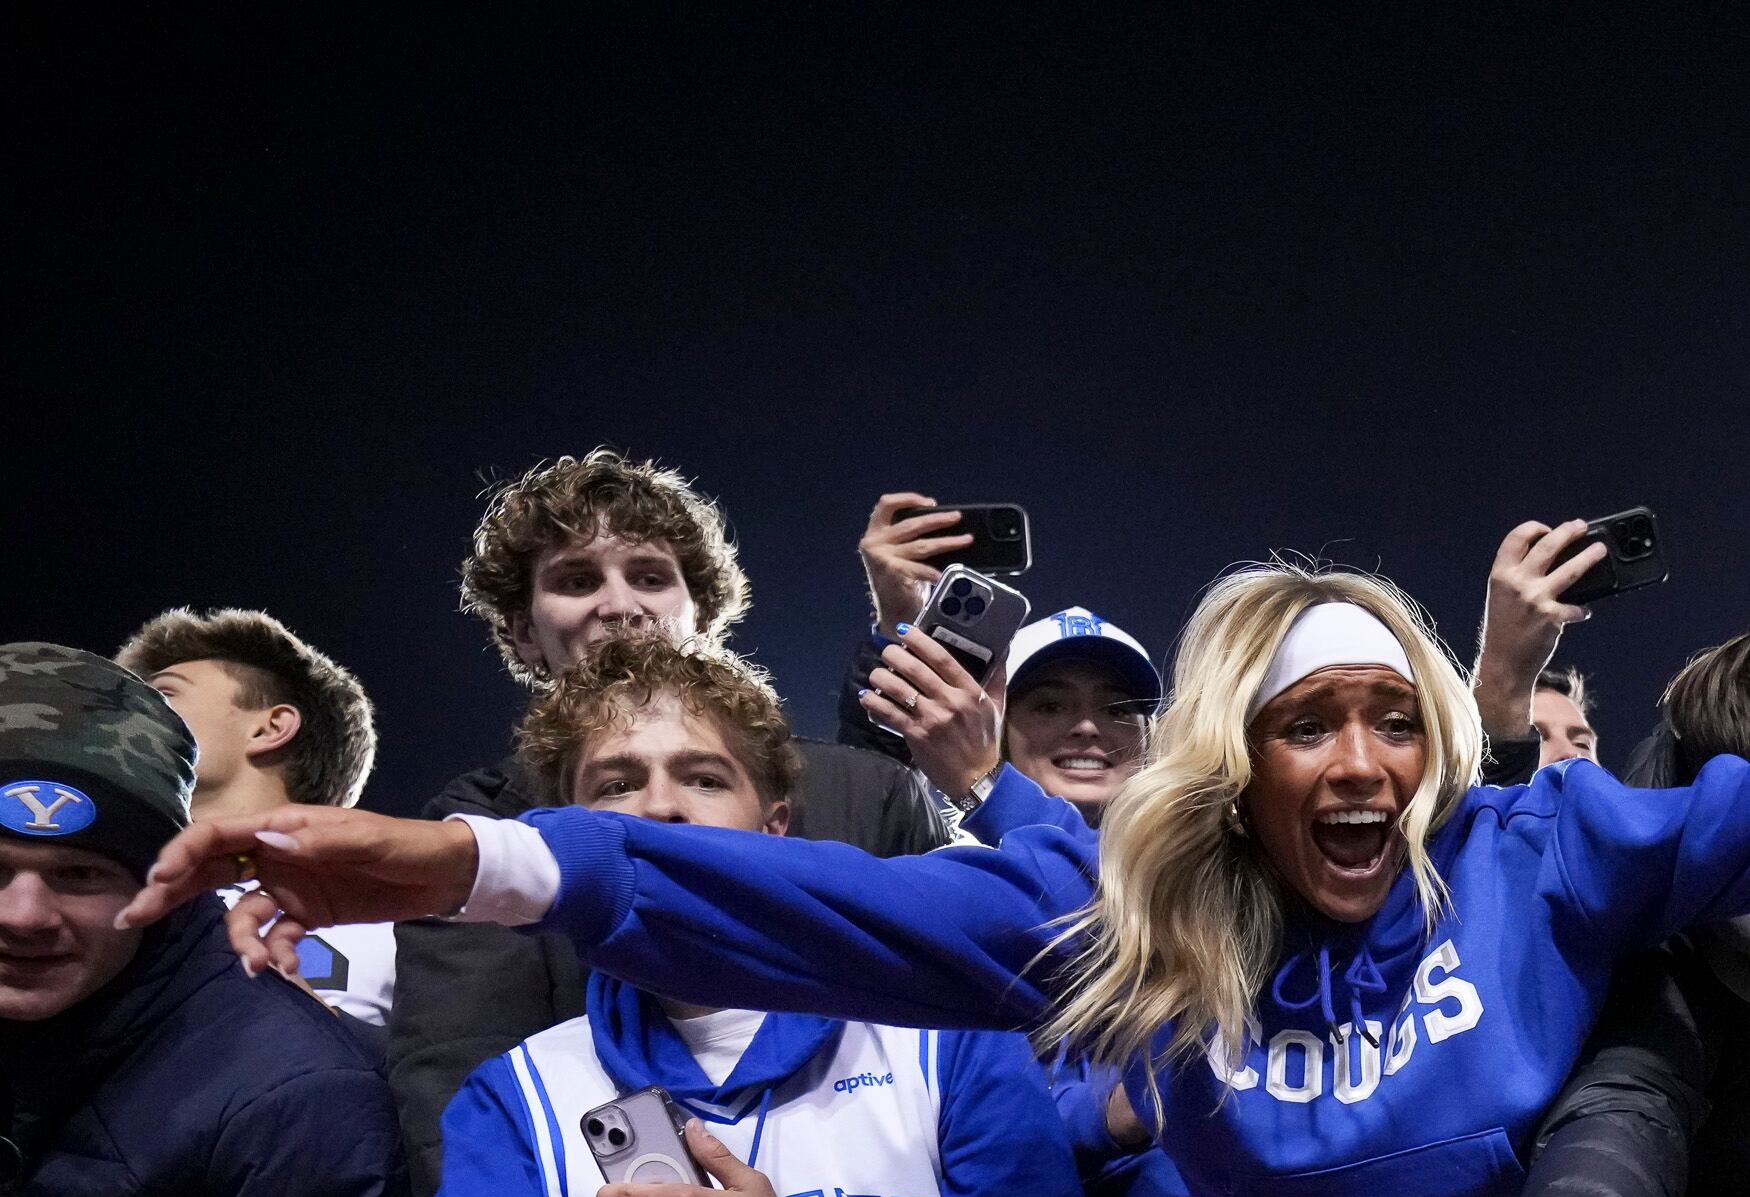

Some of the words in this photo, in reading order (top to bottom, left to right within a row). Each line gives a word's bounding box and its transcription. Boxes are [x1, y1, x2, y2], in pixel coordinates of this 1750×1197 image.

[4, 785, 81, 829] Y
[1207, 938, 1485, 1105] COUGS
[833, 1072, 894, 1093] aptive
